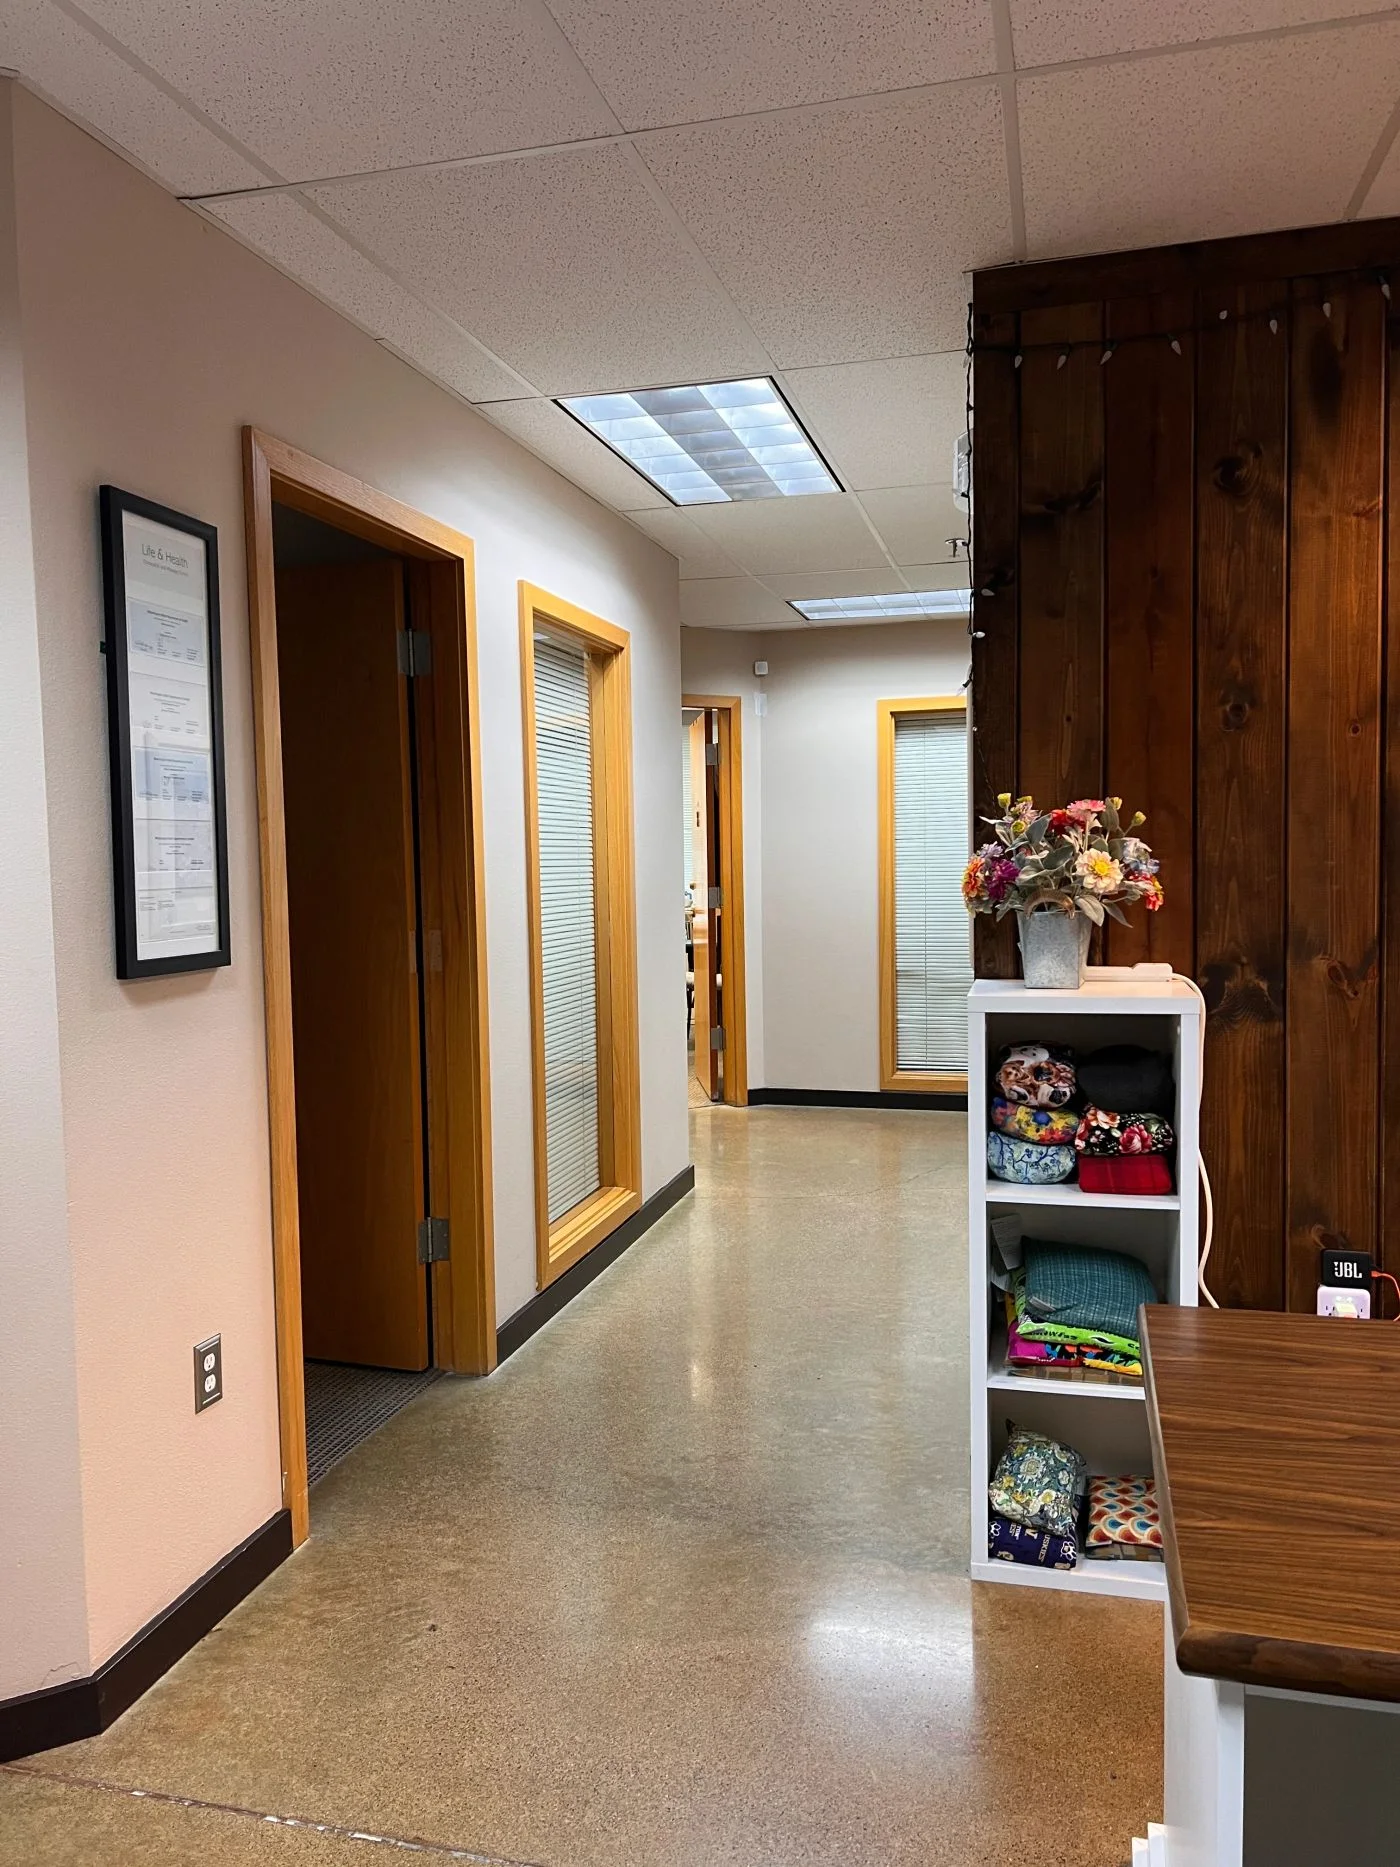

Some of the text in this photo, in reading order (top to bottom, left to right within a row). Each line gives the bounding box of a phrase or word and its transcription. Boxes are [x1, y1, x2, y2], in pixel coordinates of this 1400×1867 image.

[142, 544, 155, 558] Life
[157, 548, 163, 560] &
[165, 551, 188, 568] Health
[1333, 1261, 1362, 1278] JBL
[1038, 1534, 1051, 1563] USKIES
